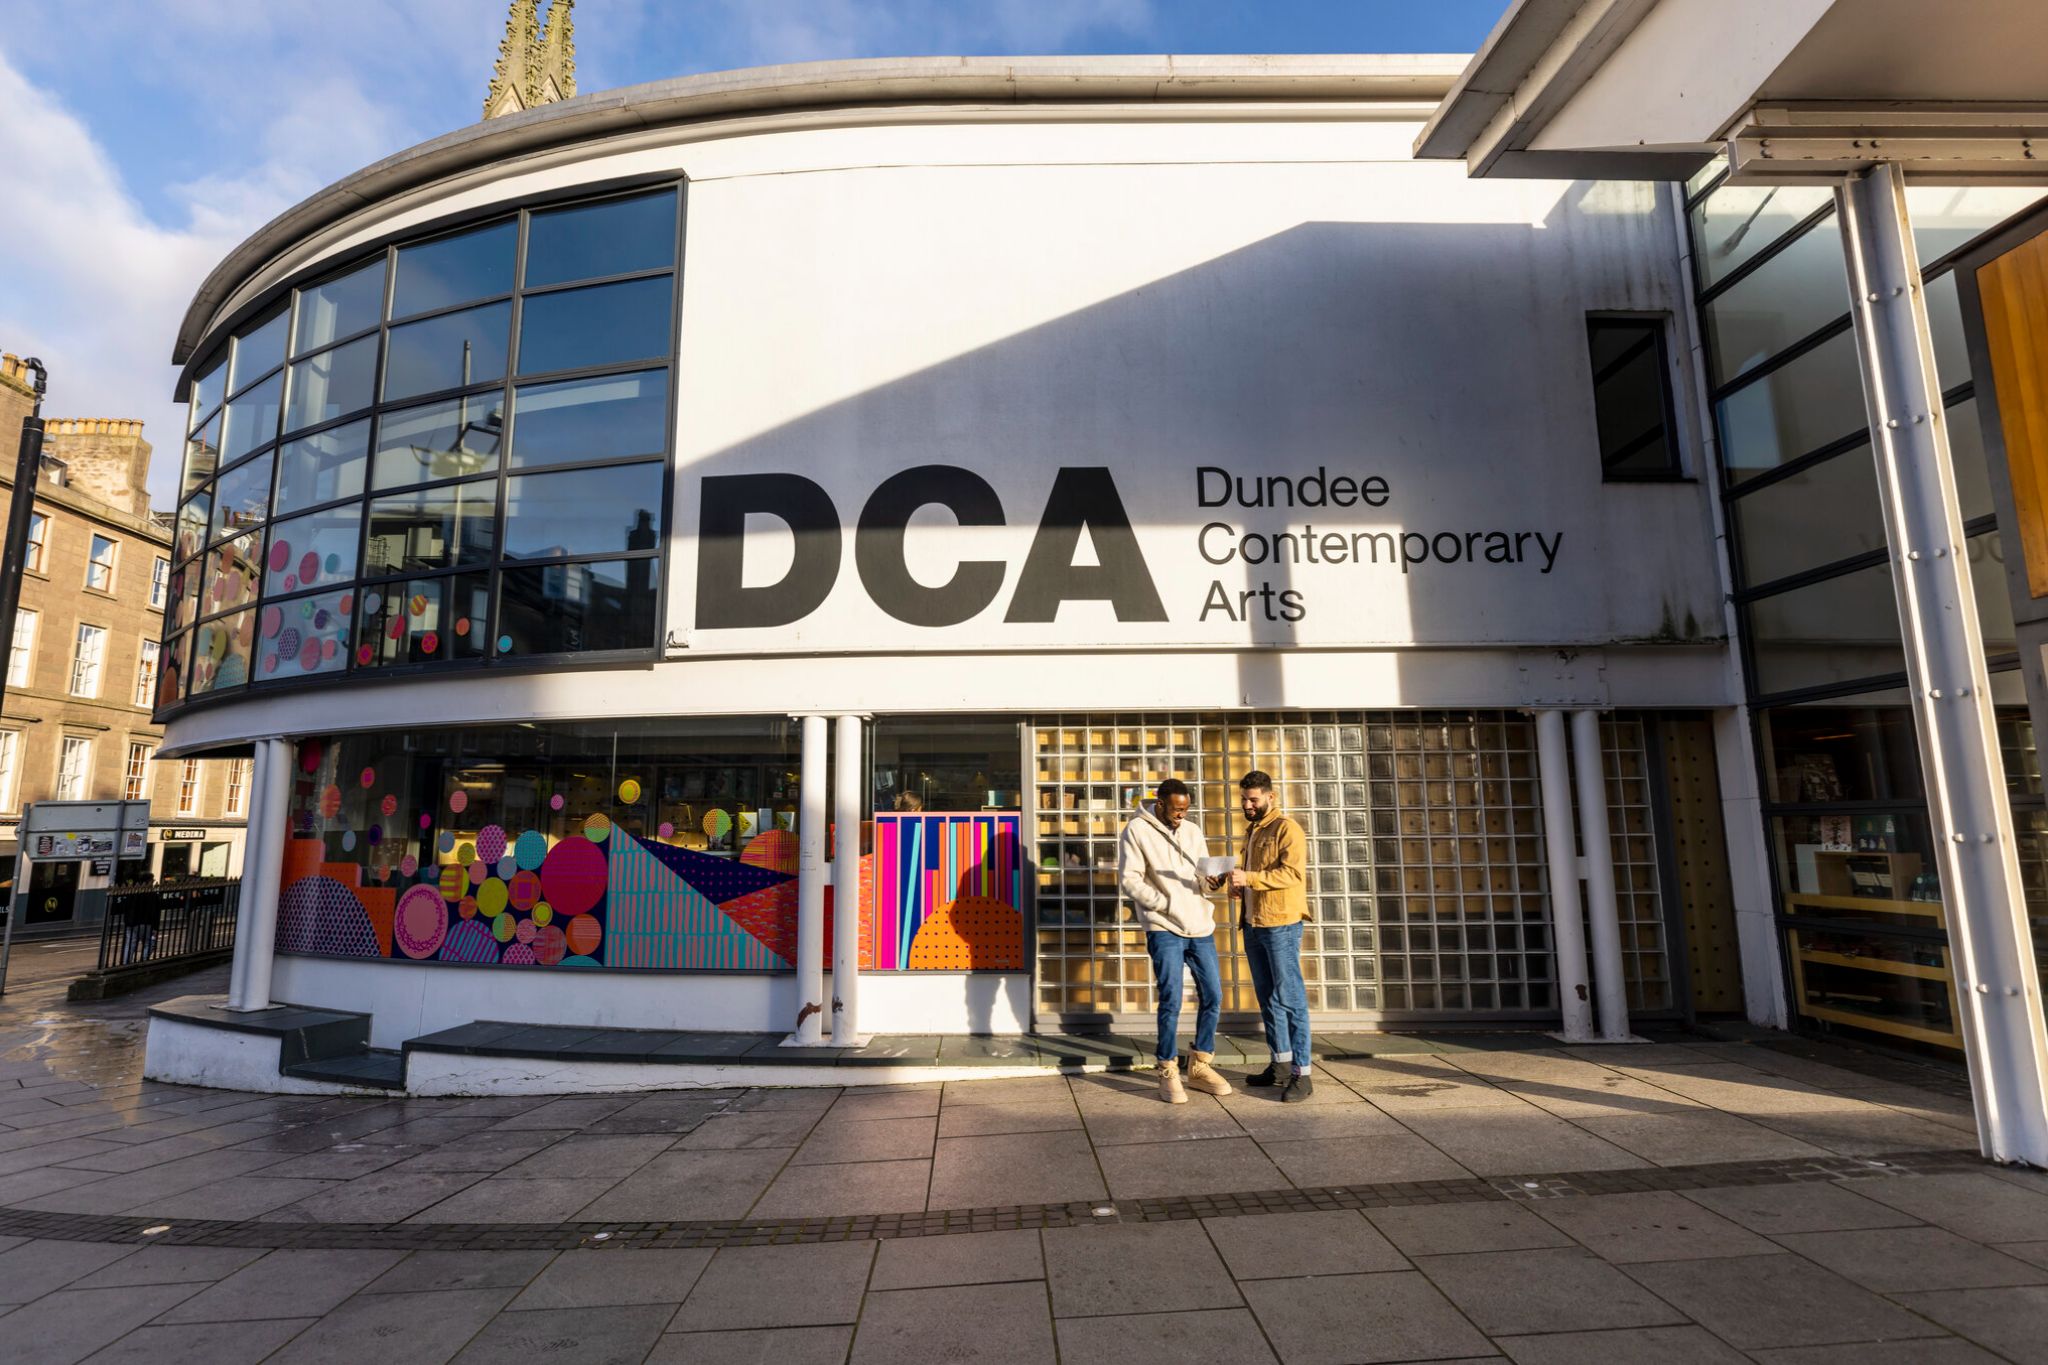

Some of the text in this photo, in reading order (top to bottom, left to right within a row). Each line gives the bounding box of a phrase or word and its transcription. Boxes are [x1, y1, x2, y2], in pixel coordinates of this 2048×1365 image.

[1195, 465, 1391, 509] Dundee
[694, 463, 1170, 630] DCA
[1197, 521, 1564, 574] Contemporary
[1198, 579, 1307, 623] Arts
